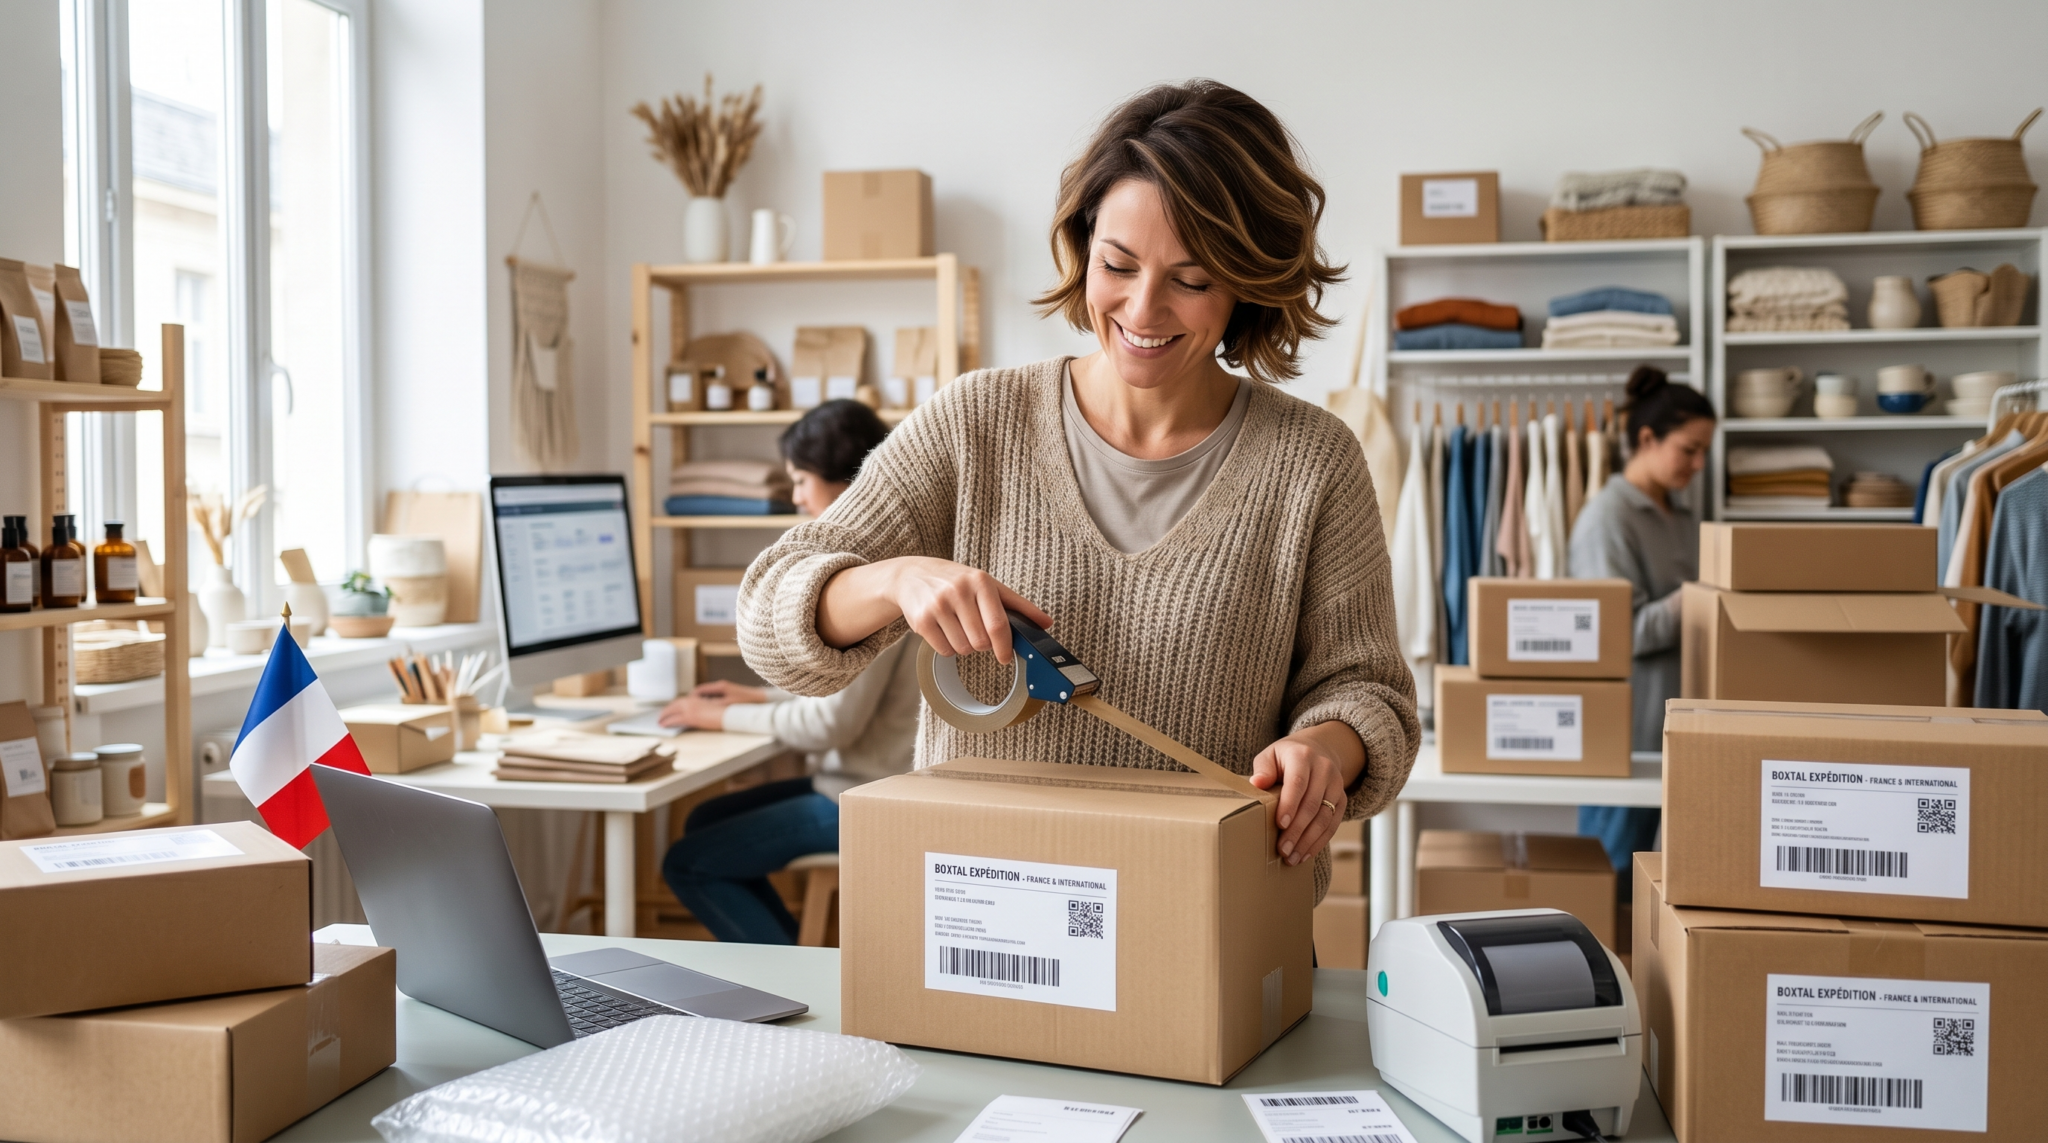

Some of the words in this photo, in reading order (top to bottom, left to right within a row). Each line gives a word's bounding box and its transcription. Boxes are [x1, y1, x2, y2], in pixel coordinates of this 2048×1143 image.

[1772, 770, 1807, 782] BOXTAL
[1810, 771, 1863, 784] EXPÉDITION
[1870, 777, 1896, 785] FRANCE
[1904, 778, 1958, 788] INTERNATIONAL
[935, 864, 968, 876] BOXTAL
[970, 867, 1020, 882] EXPÉDITION
[1026, 875, 1051, 885] FRANCE
[1058, 879, 1107, 890] INTERNATIONAL
[1777, 986, 1815, 998] BOXTAL
[1818, 987, 1876, 1001] EXPÉDITION
[1884, 994, 1912, 1002] FRANCE
[1920, 996, 1977, 1006] INTERNATIONAL
